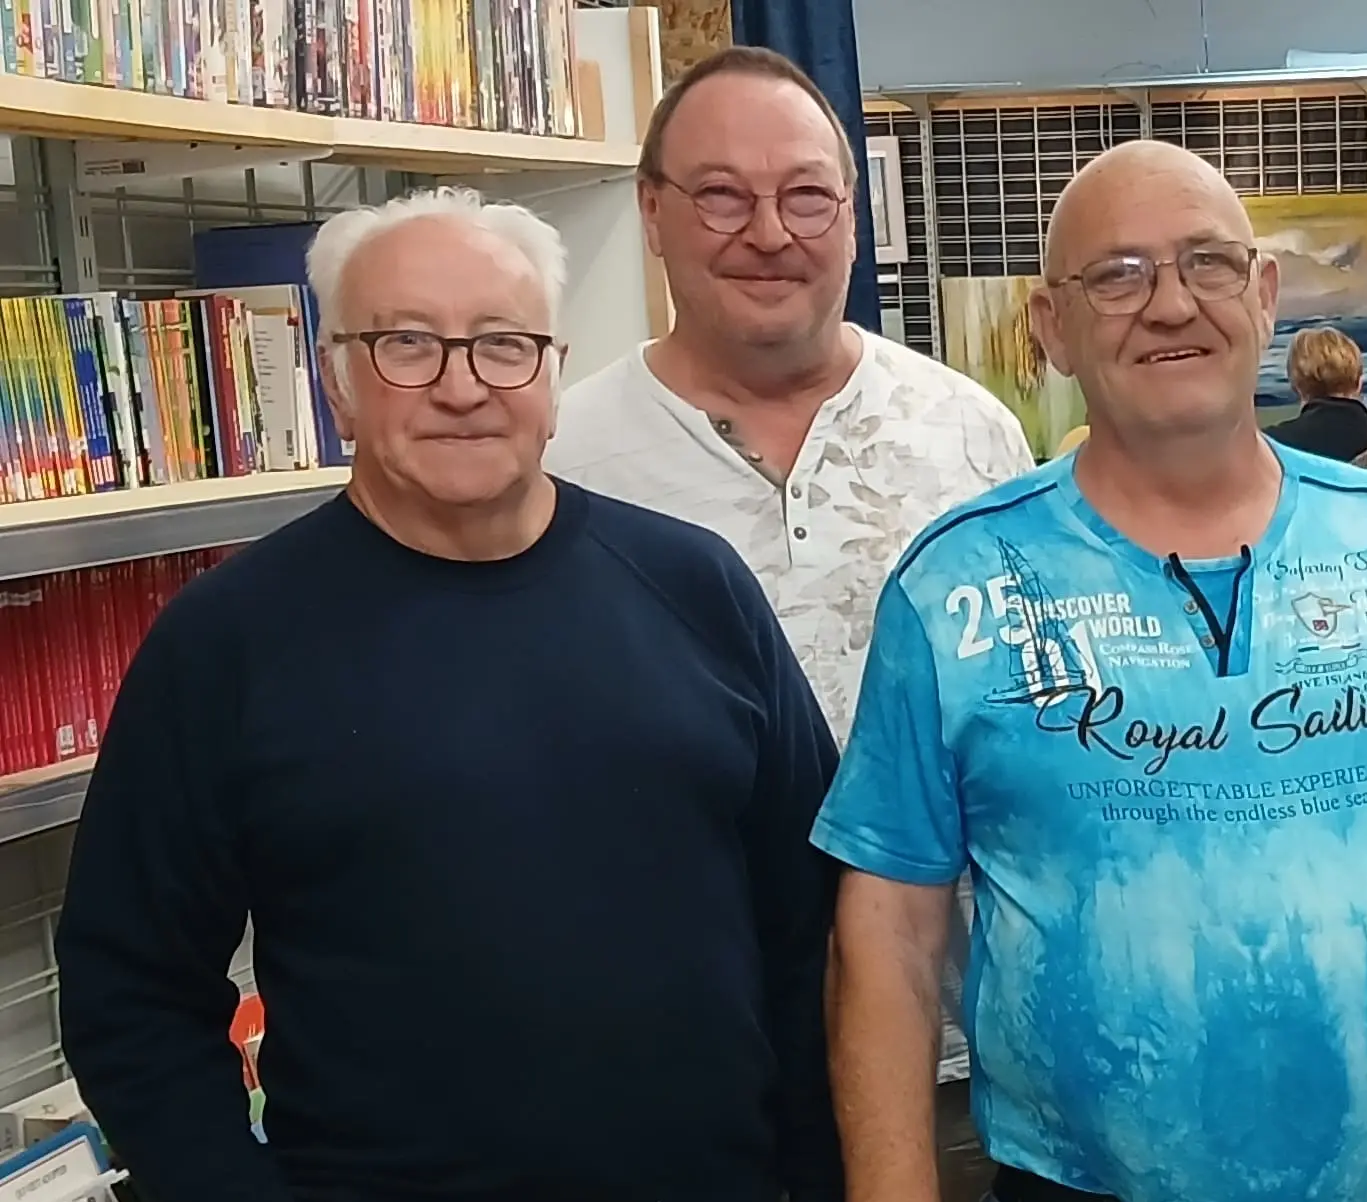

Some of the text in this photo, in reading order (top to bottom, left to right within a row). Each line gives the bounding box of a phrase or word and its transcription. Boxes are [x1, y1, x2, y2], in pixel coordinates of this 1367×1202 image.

[1089, 615, 1162, 639] WORLD
[1108, 655, 1191, 669] NAVIGATION
[1035, 686, 1229, 776] Royal
[1067, 778, 1276, 800] UNFORGETTABLE
[1101, 801, 1183, 826] through
[1186, 805, 1218, 823] the
[1223, 802, 1297, 822] endless
[1301, 797, 1341, 816] blue
